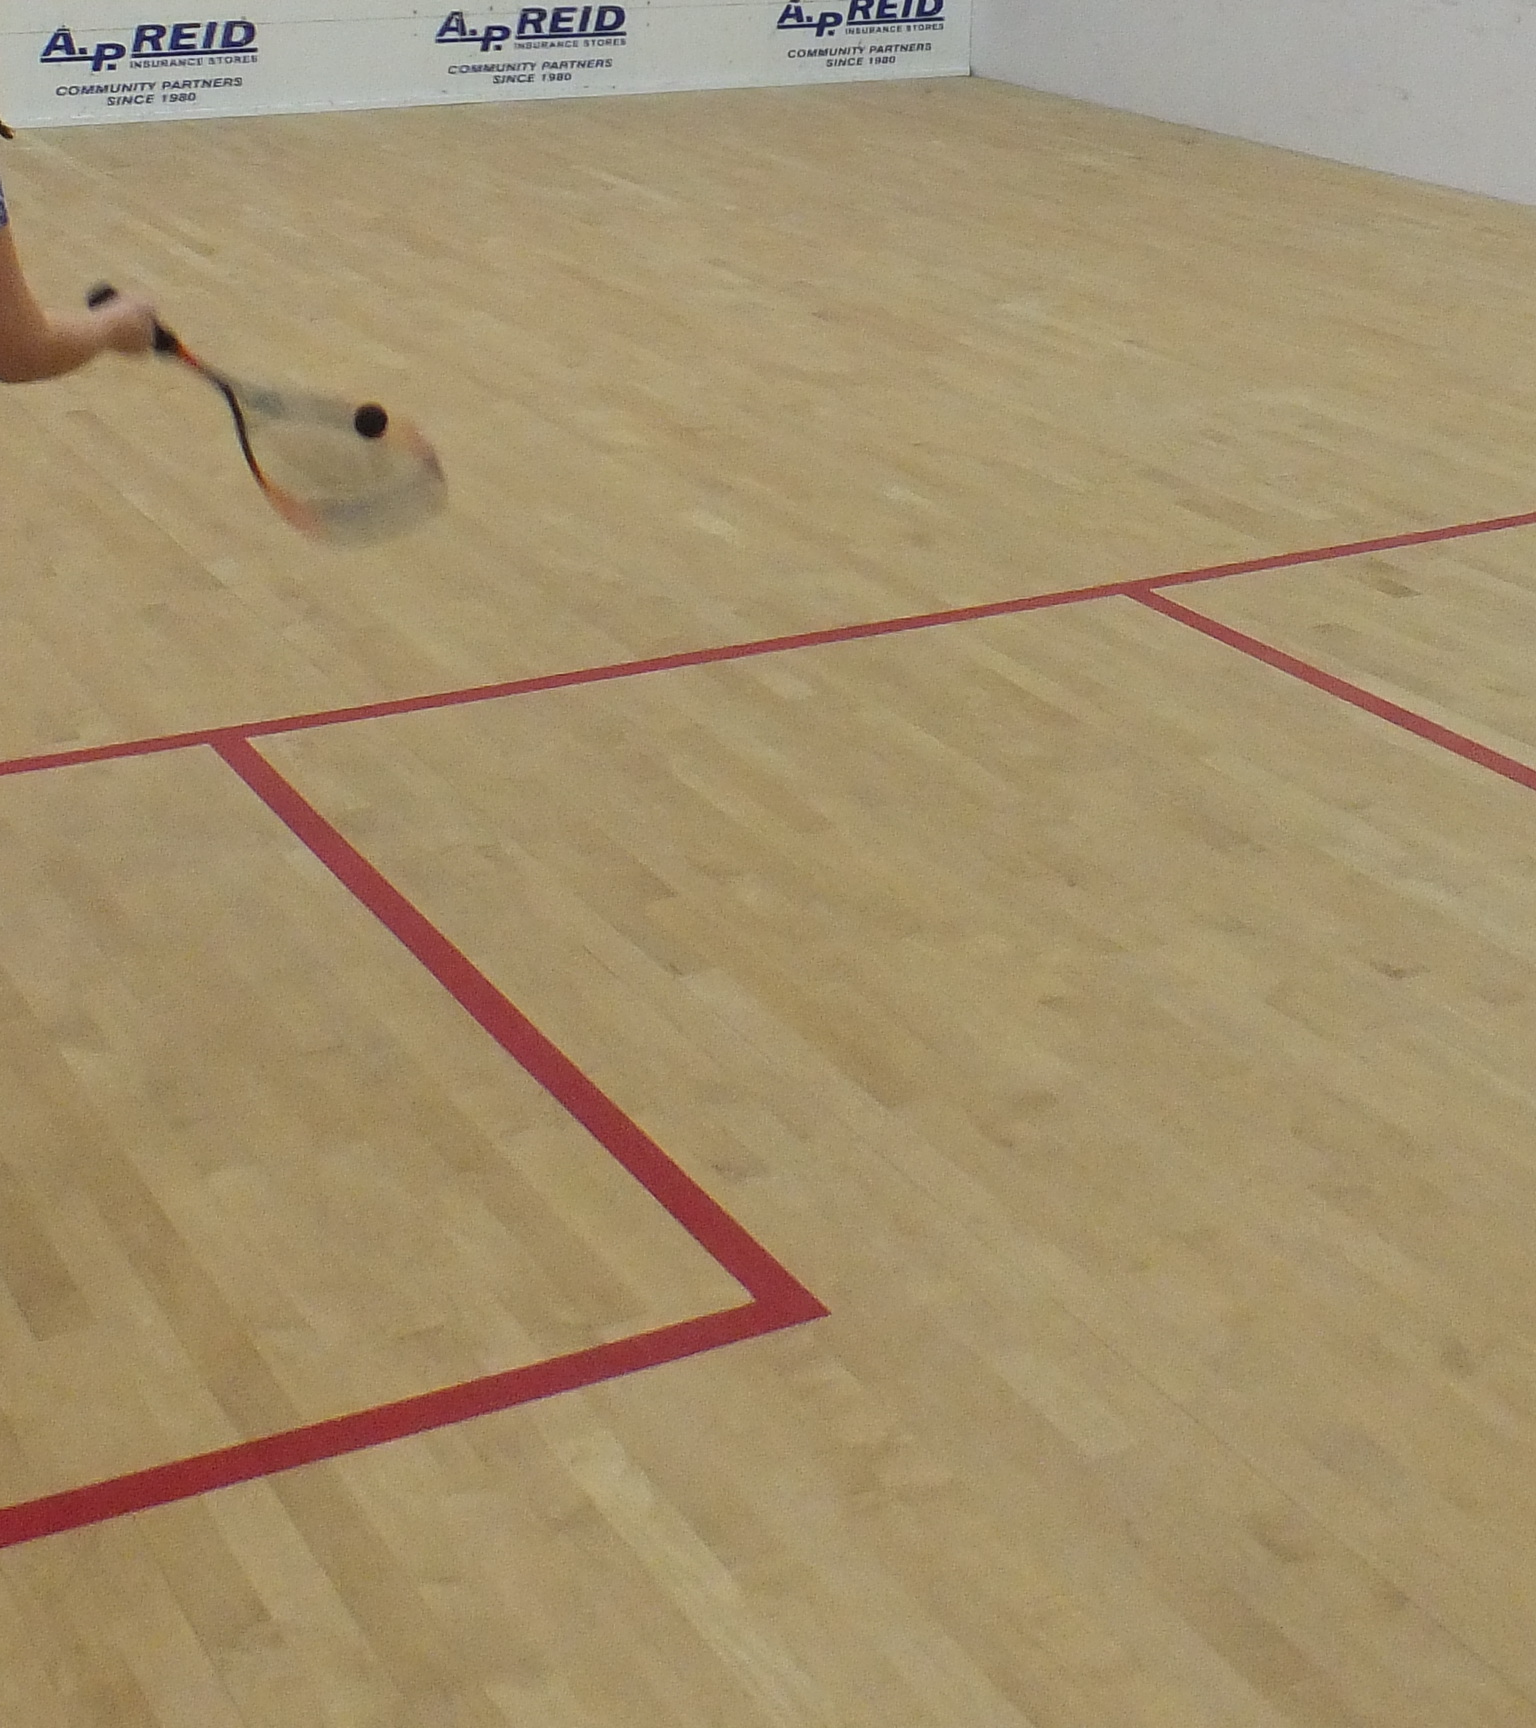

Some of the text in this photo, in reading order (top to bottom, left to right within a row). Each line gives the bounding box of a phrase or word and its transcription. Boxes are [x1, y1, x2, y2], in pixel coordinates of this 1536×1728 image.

[515, 5, 627, 39] REID
[845, 23, 945, 35] INSURANCE STORES
[131, 20, 258, 58] REID
[514, 38, 627, 50] INSURANCE STORES
[787, 42, 932, 59] COMMUNITY PARTNERS
[129, 55, 259, 70] INSURANCE STORES
[448, 58, 613, 75] COMMUNITY PARTNERS
[826, 56, 896, 68] SINCE 1980
[492, 72, 572, 84] SINCE 1980
[55, 77, 243, 97] COMMUNITY PARTNERS
[107, 92, 197, 106] SINCE 1980
